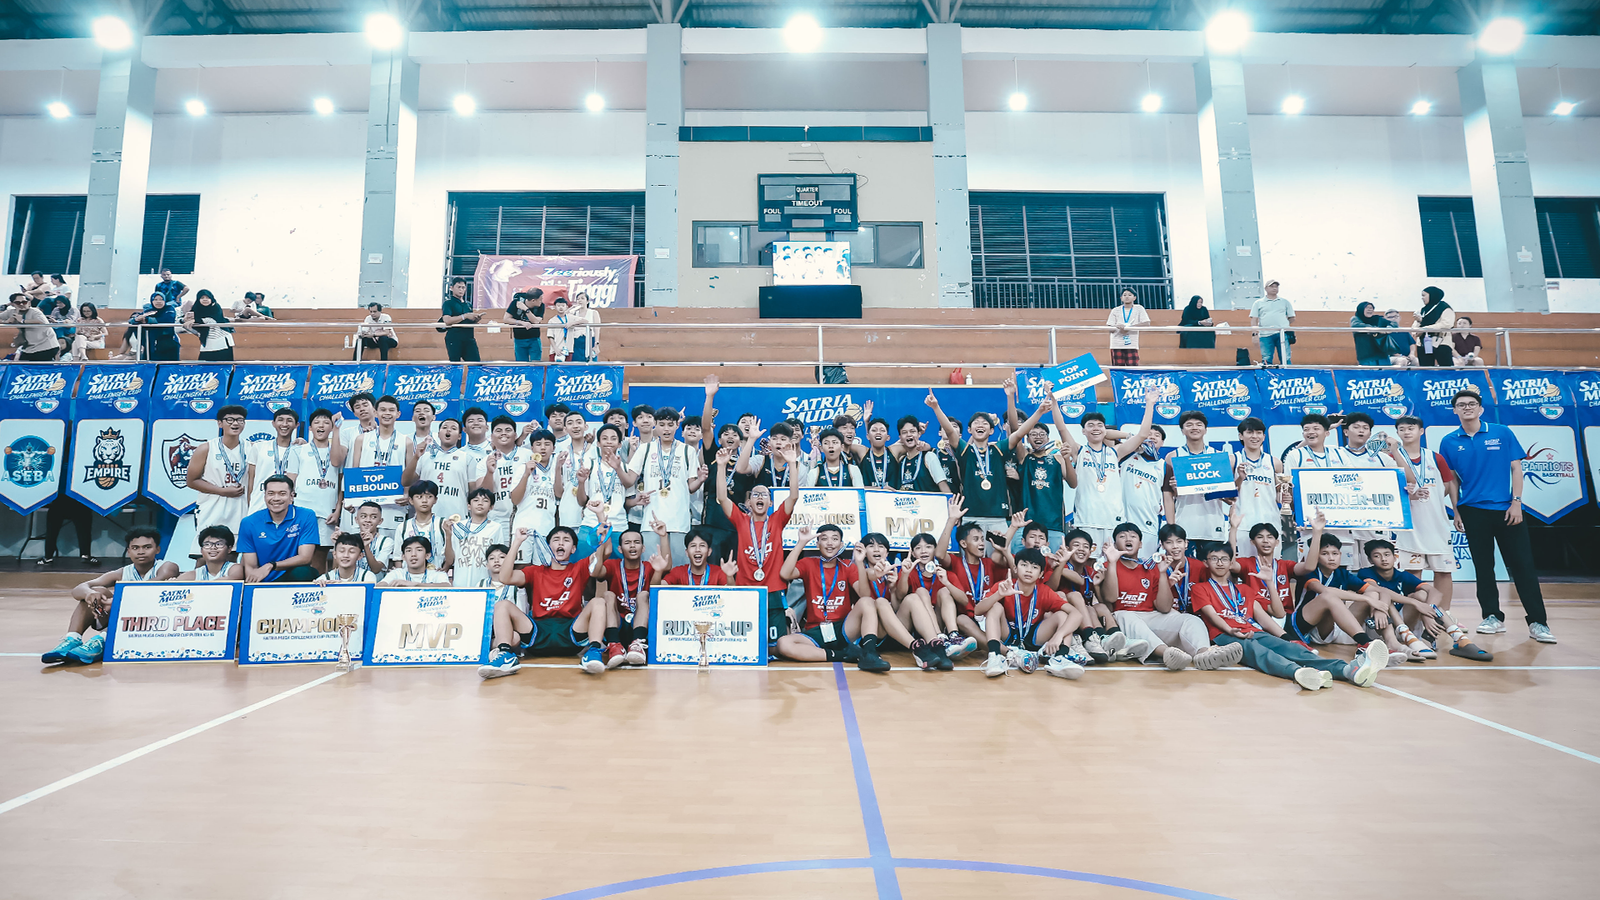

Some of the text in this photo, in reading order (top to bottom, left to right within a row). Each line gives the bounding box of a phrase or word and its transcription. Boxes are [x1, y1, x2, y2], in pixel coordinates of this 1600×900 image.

[541, 266, 618, 281] Zeeriously
[1058, 368, 1088, 385] POINT
[1060, 365, 1079, 376] TOP
[11, 372, 62, 386] SATRIA
[88, 371, 137, 386] SATRIA
[164, 372, 218, 386] SATRIA
[240, 373, 291, 386] SATRIA
[318, 371, 368, 386] SATRIA
[394, 373, 446, 387] SATRIA
[474, 373, 526, 388] SATRIA
[554, 373, 605, 387] SATRIA
[1121, 377, 1170, 390] SATRIA
[1191, 378, 1239, 392] SATRIA
[1268, 376, 1316, 390] SATRIA
[1346, 377, 1395, 391] SATRIA
[1422, 378, 1470, 391] SATRIA
[1502, 377, 1550, 391] SATRIA
[8, 380, 54, 395] MUDA
[86, 380, 131, 395] MUDA
[161, 380, 207, 395] MUDA
[238, 381, 285, 395] MUDA
[317, 380, 361, 395] MUDA
[393, 381, 439, 396] MUDA
[473, 383, 519, 397] MUDA
[553, 383, 600, 397] MUDA
[1270, 386, 1312, 400] MUDA
[1350, 386, 1391, 400] MUDA
[1505, 387, 1547, 401] MUDA
[9, 391, 50, 401] CHALLENGER
[88, 391, 127, 401] CHALLENGER
[163, 391, 202, 401] CHALLENGER
[240, 391, 280, 401] CHALLENGER
[395, 392, 433, 401] CHALLENGER
[475, 394, 517, 402] CHALLENGER
[556, 393, 597, 402] CHALLENGER
[1194, 388, 1237, 402] MUDA
[1510, 397, 1549, 406] CHALLENGER
[781, 394, 852, 414] SATRIA
[1198, 398, 1237, 408] CHALLENGER
[1274, 397, 1312, 407] CHALLENGER
[1354, 397, 1392, 407] CHALLENGER
[434, 462, 451, 471] THE
[498, 466, 513, 475] THE
[1191, 462, 1212, 471] TOP
[1520, 461, 1574, 471] PATRIOTS
[1, 470, 54, 482] ASEBA
[87, 467, 129, 479] EMPIRE
[363, 475, 384, 483] TOP
[437, 473, 444, 483] 4
[1126, 466, 1158, 483] PATRIOTS
[1186, 470, 1221, 480] BLOCK
[306, 478, 336, 489] CAPAIN
[349, 483, 399, 493] REBOUND
[439, 486, 460, 497] TAIN
[536, 498, 548, 509] 31
[1306, 493, 1394, 506] RUNNER-UP
[786, 513, 856, 525] HAMPIONS
[885, 516, 934, 537] MVP
[458, 557, 487, 567] THE SK
[159, 594, 187, 603] MUDA
[160, 588, 190, 597] SATRIA
[293, 590, 323, 600] SATRIA
[692, 594, 721, 602] SATRIA
[292, 597, 320, 606] MUDA
[692, 599, 718, 608] MUDA
[121, 616, 226, 631] THIRD PLACE
[398, 623, 463, 649] MVP
